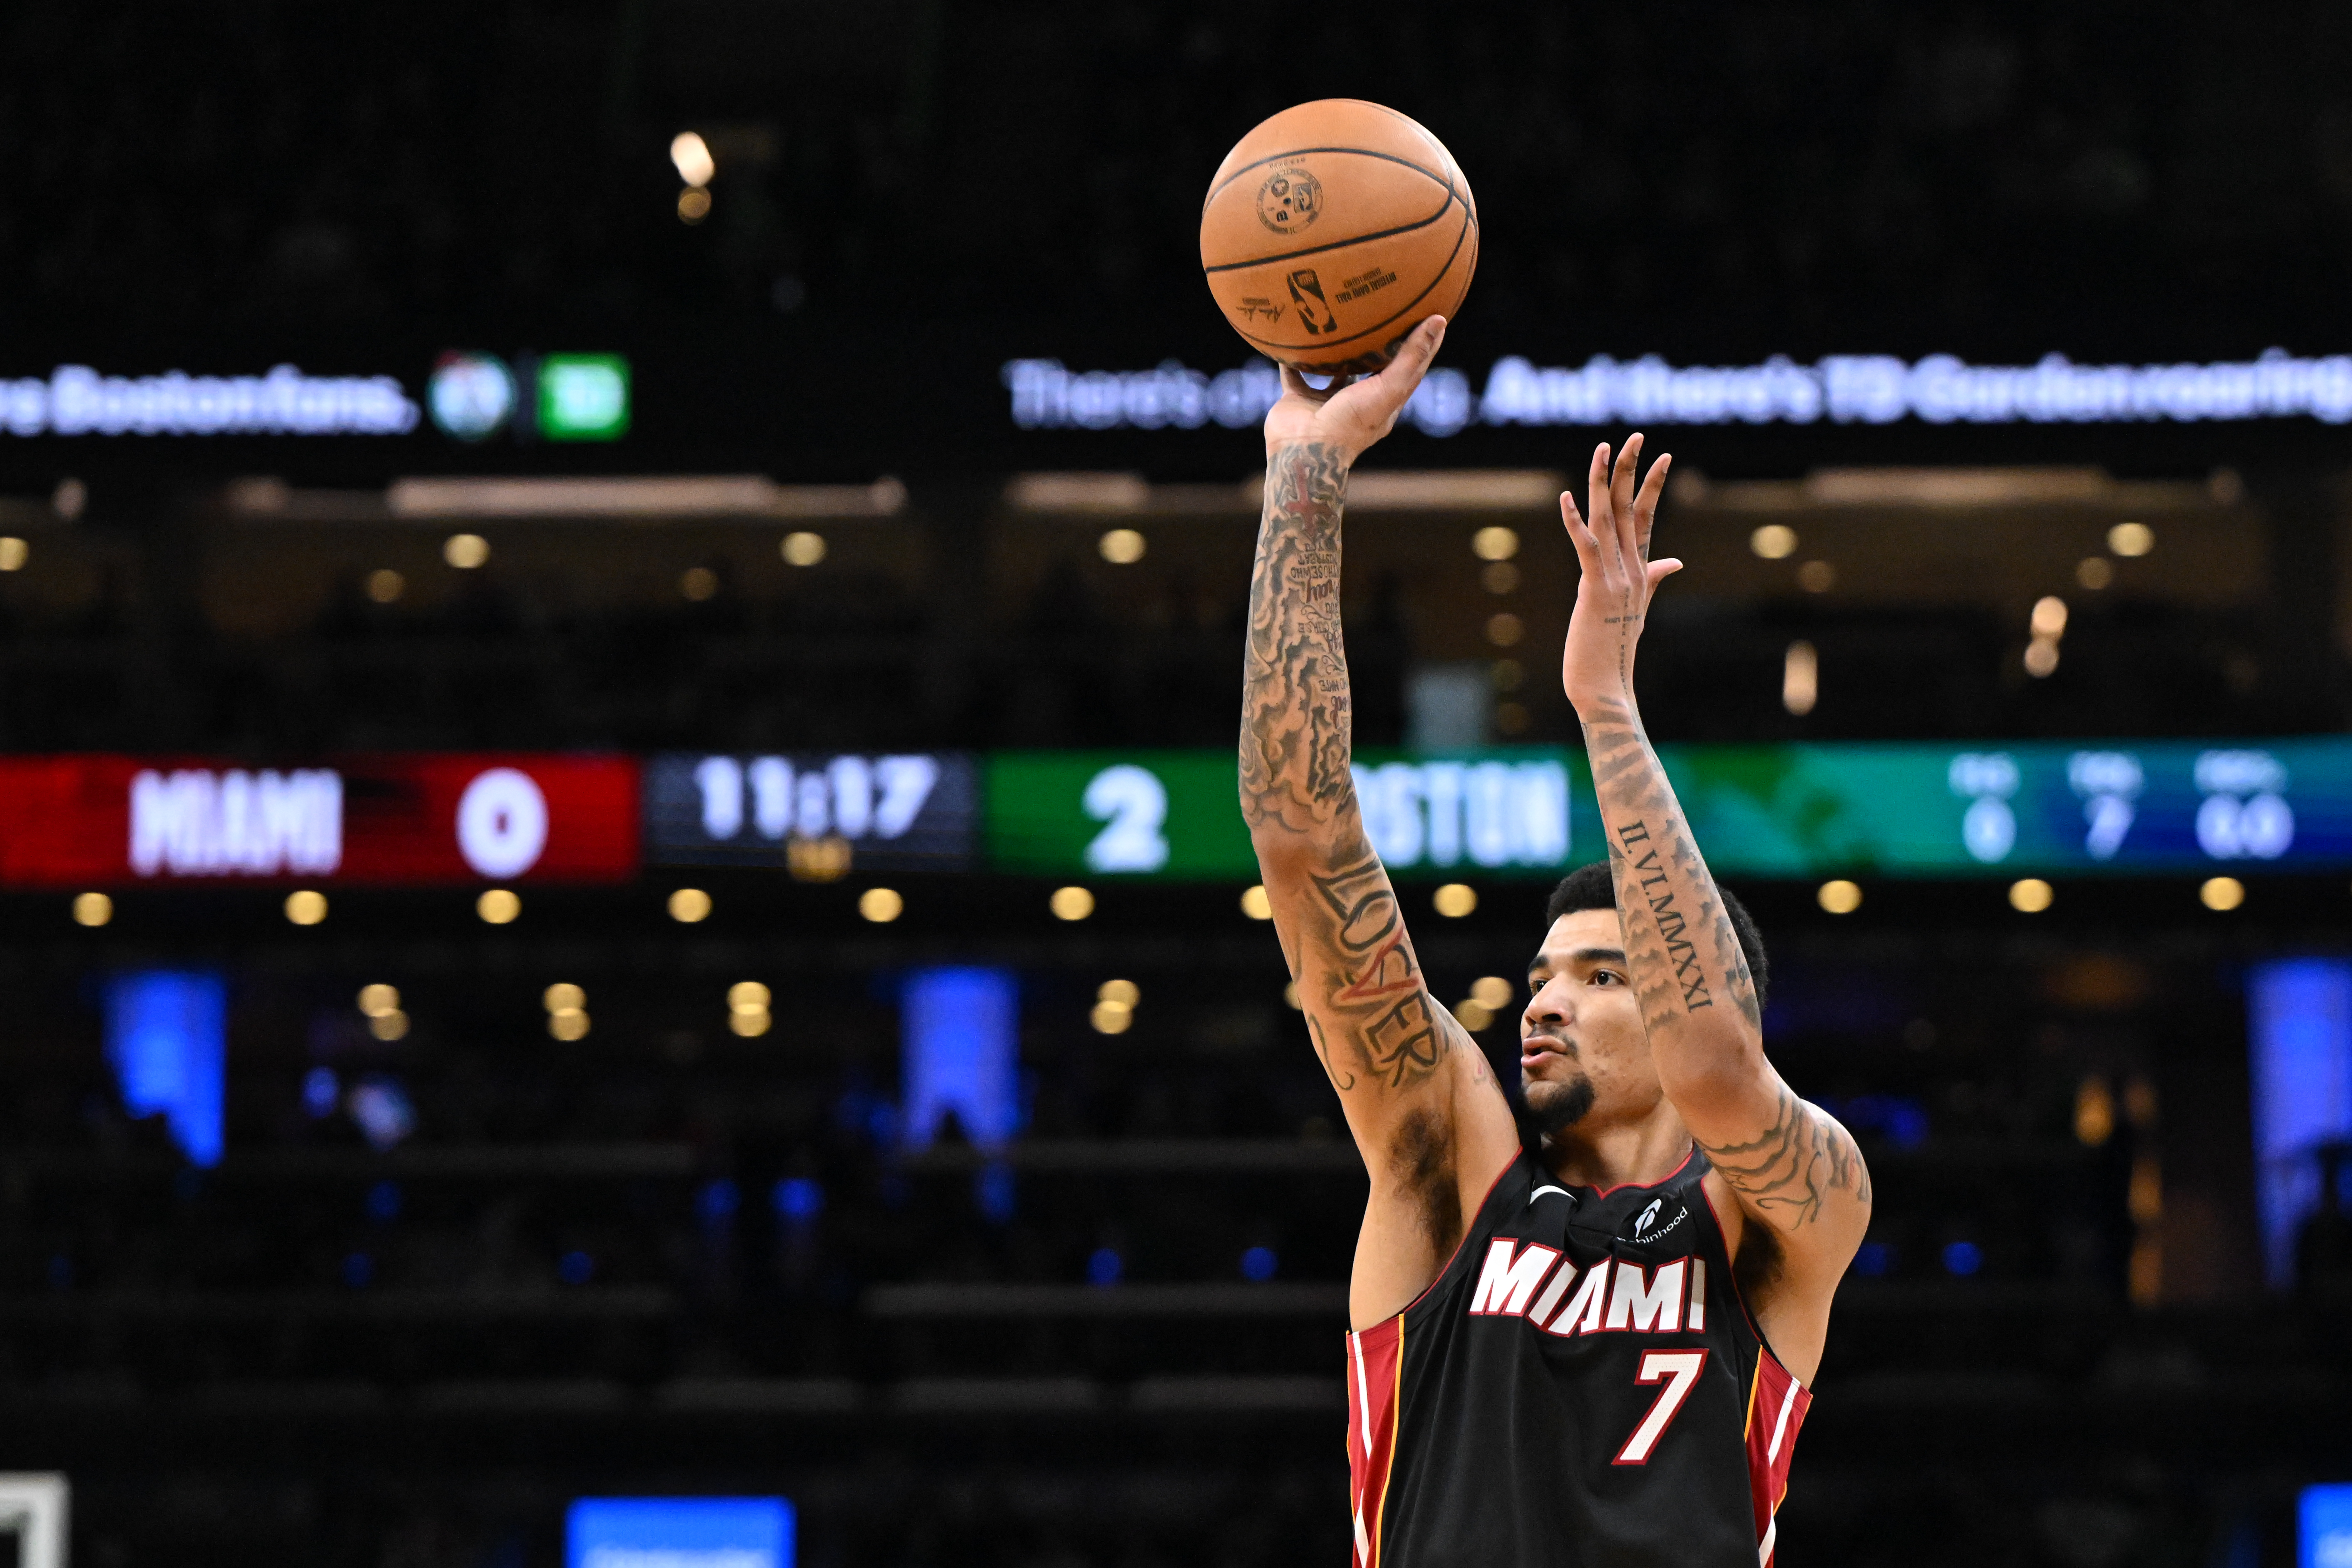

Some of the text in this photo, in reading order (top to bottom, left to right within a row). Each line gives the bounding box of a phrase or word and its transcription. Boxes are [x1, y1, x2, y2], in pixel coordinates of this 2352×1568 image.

[129, 768, 343, 877] MIAMI
[455, 768, 549, 879] 0
[696, 755, 937, 840] 11:17
[1083, 764, 1170, 873] 2
[1468, 1237, 1706, 1338] MIAMI
[1610, 1348, 1709, 1465] 7
